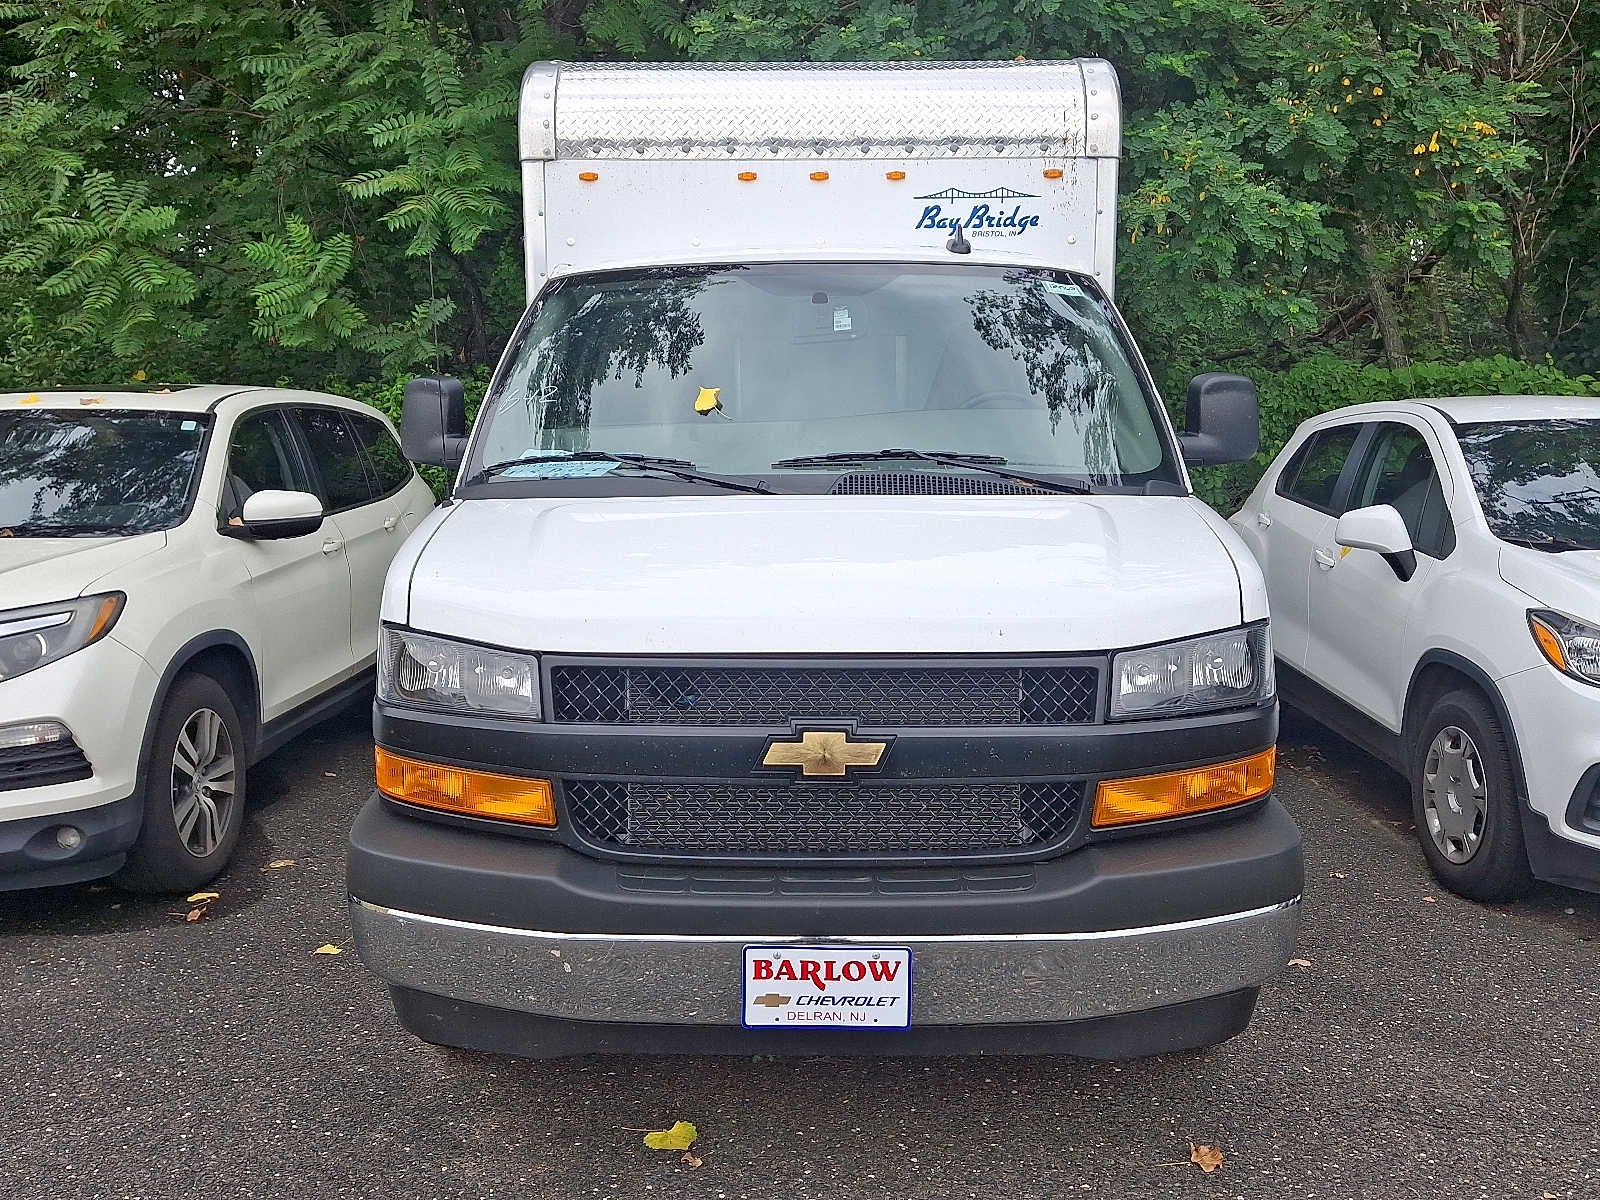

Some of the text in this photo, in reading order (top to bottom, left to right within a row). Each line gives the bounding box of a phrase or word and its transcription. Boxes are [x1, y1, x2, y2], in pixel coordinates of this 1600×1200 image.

[915, 203, 1040, 236] Bay Bridge
[971, 230, 1007, 238] BRISTOL,
[752, 959, 902, 991] BARLOW
[795, 995, 901, 1007] CHEVROLET
[787, 1011, 867, 1022] DELRAN, NJ
